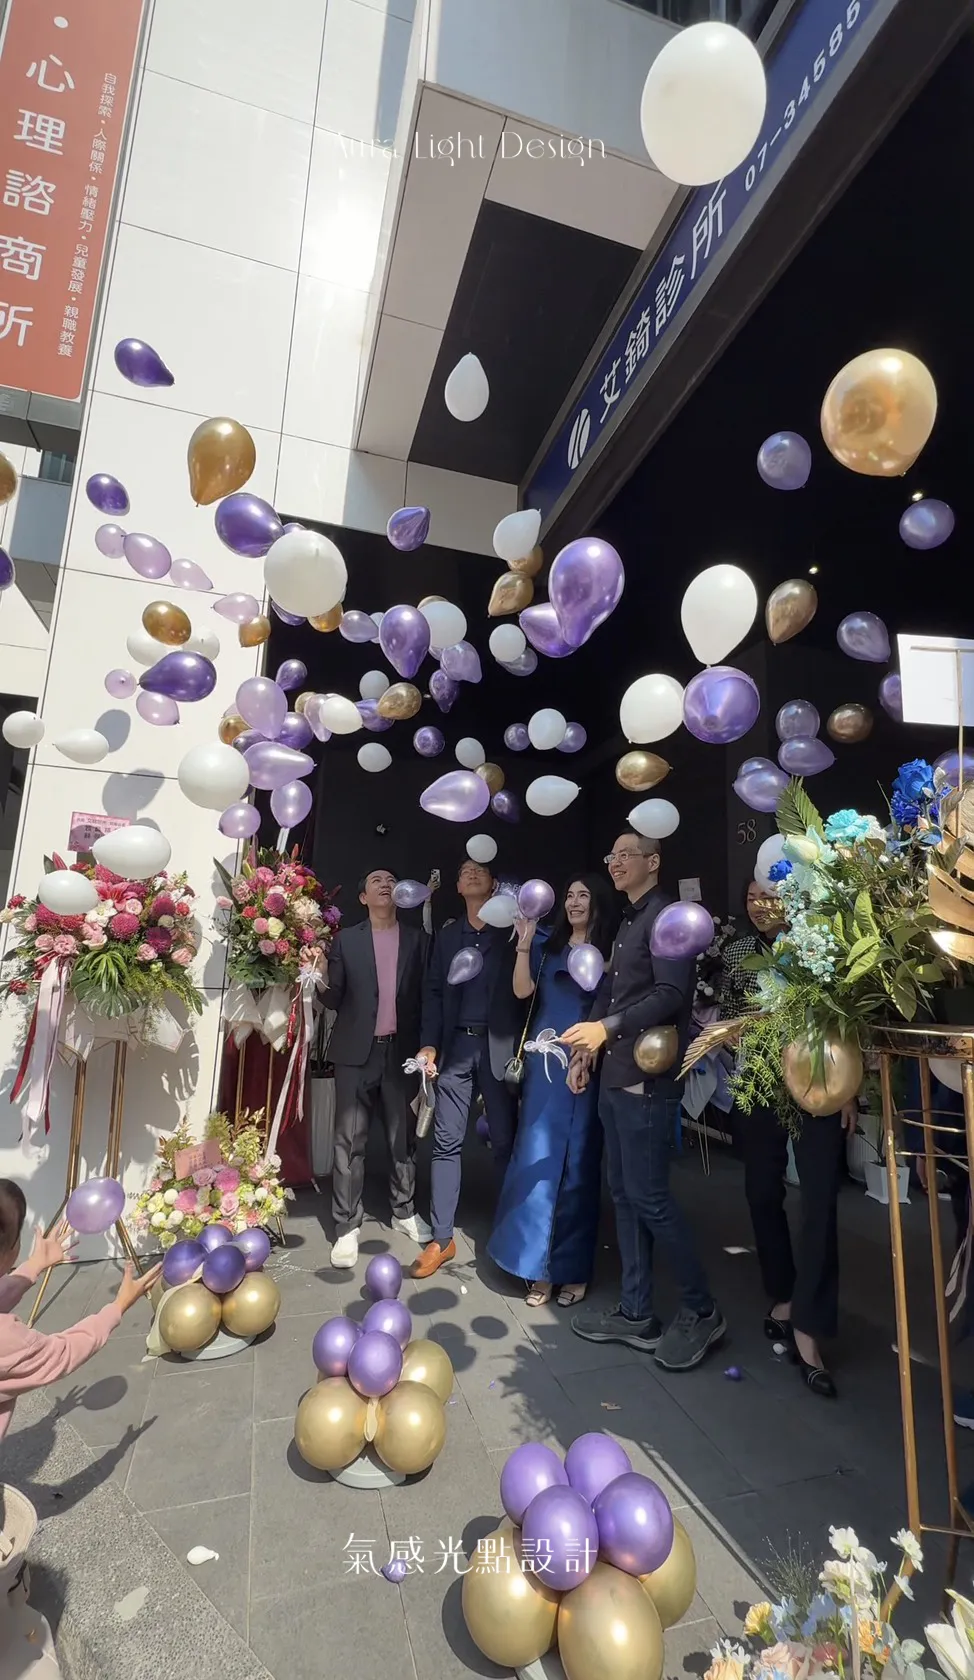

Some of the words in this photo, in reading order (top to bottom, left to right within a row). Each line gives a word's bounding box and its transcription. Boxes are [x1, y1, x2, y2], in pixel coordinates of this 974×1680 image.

[600, 177, 727, 424] 艾錡診所
[736, 818, 757, 845] 58
